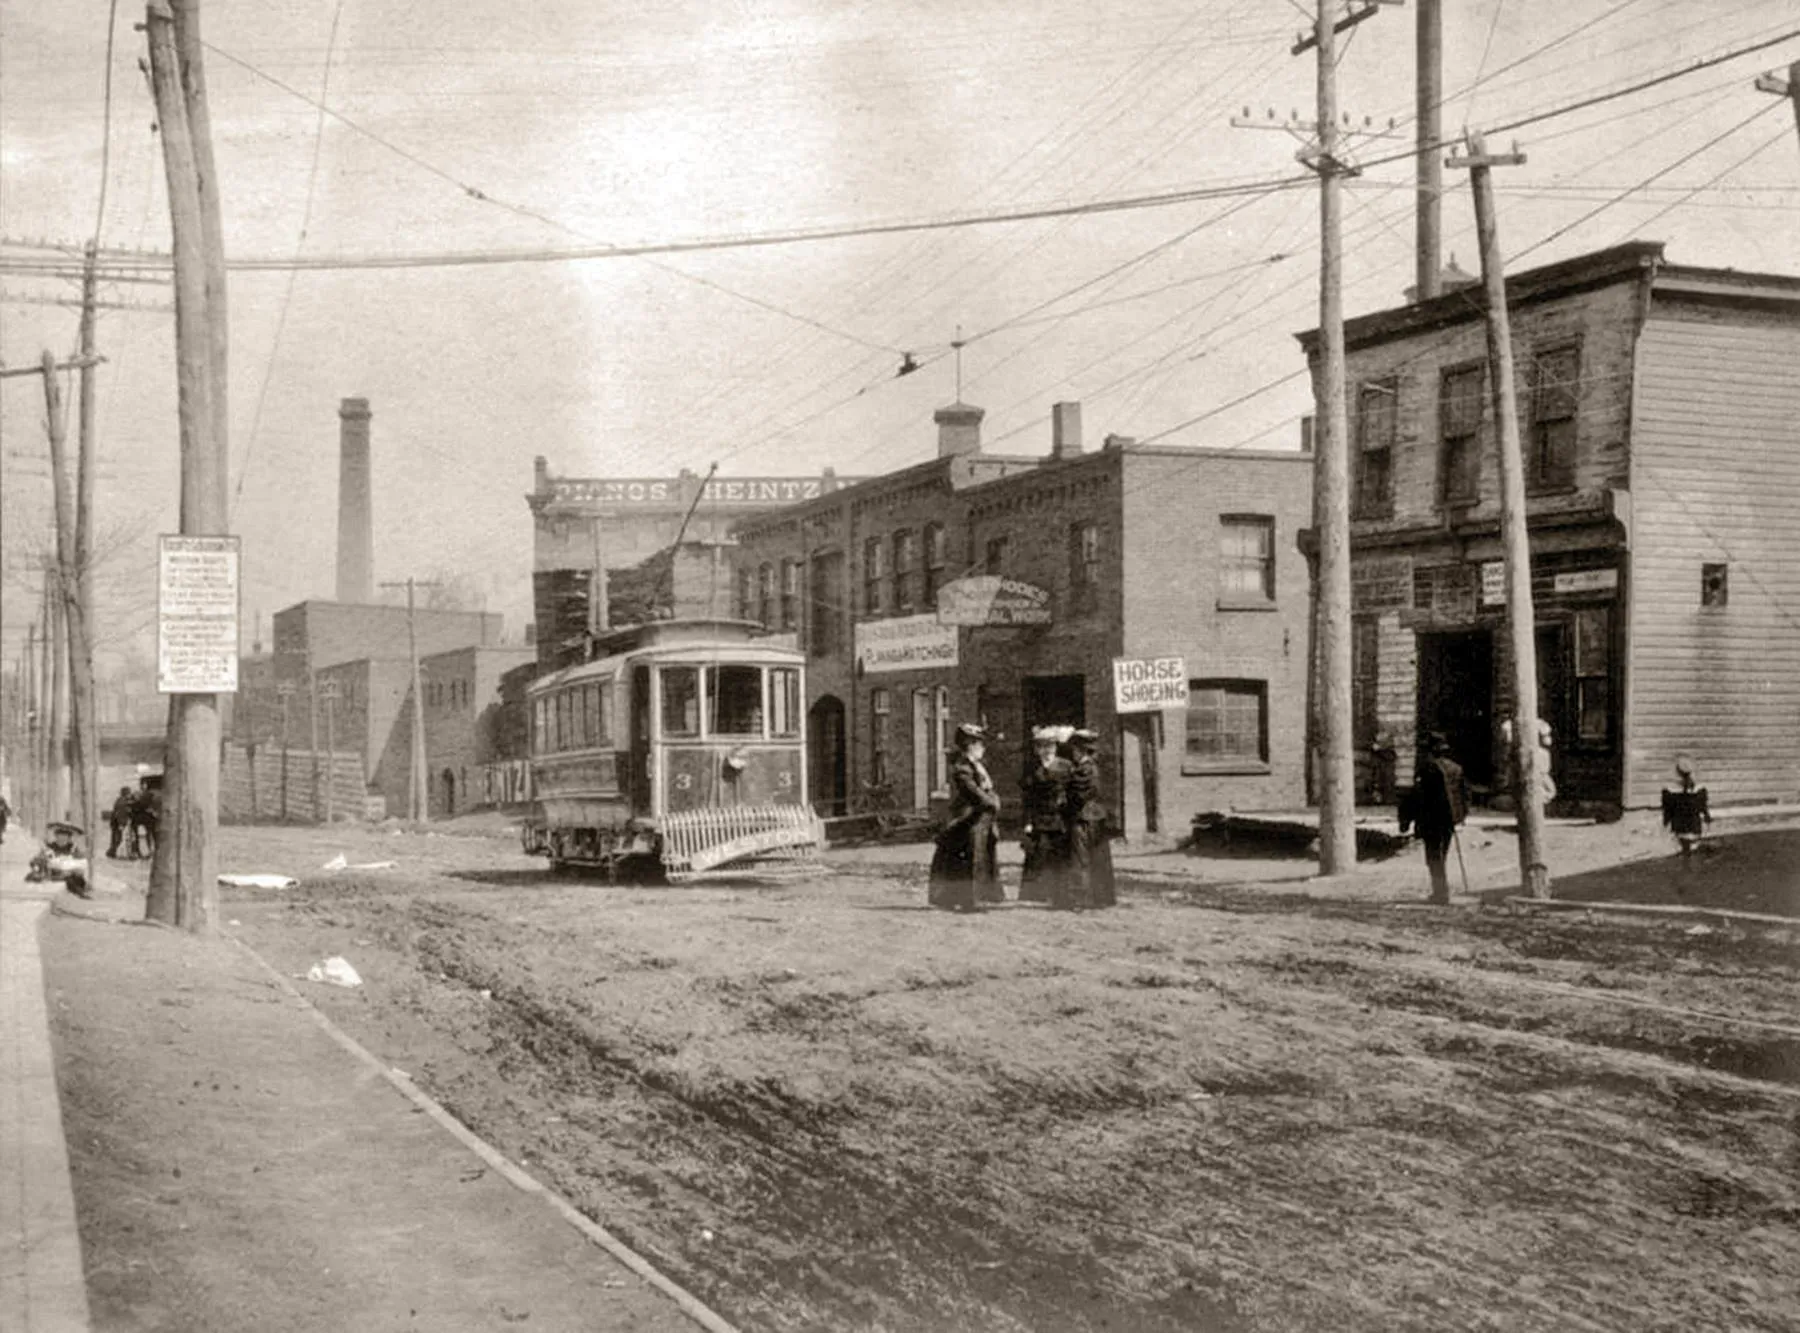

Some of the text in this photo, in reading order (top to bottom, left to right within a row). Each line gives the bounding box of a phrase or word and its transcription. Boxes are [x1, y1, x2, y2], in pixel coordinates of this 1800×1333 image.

[702, 481, 822, 501] HEINTZ
[1118, 661, 1182, 681] HORSE
[1121, 681, 1188, 704] SHOEING
[676, 773, 692, 790] 3
[778, 771, 792, 788] 3
